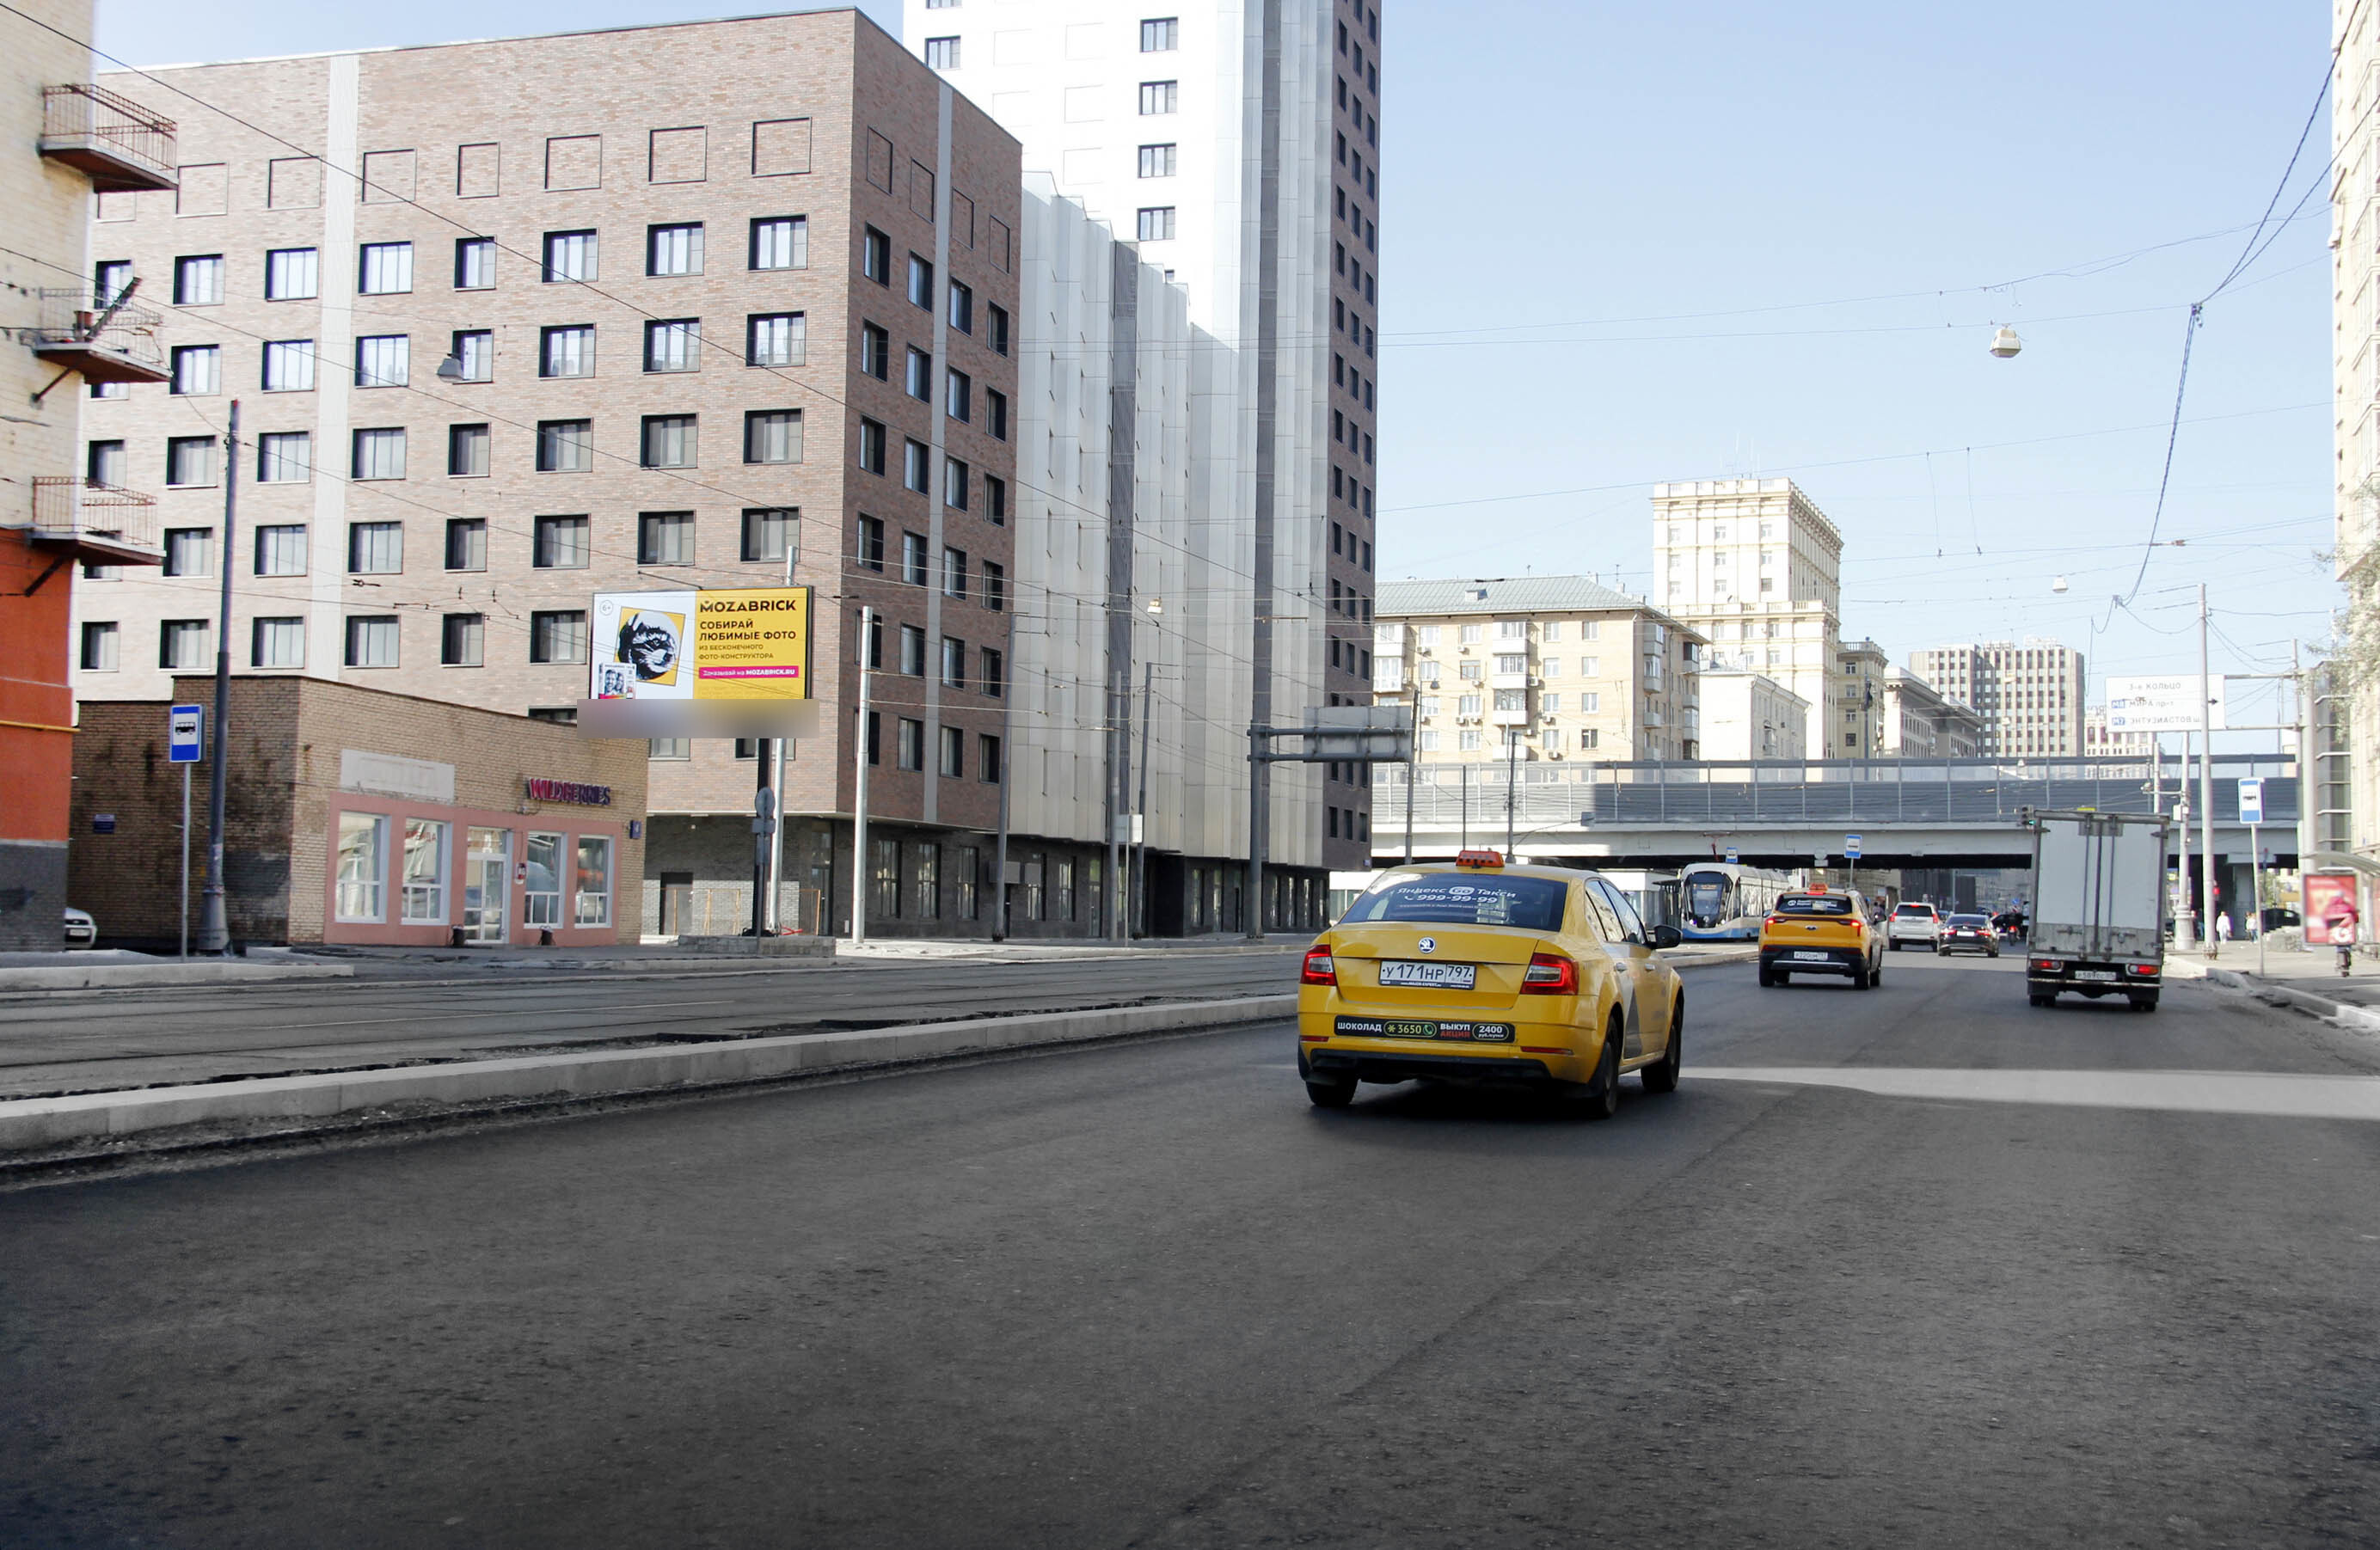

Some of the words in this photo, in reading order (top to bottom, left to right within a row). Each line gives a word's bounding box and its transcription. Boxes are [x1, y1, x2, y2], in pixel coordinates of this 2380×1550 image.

[700, 600, 796, 613] MOZABRICK
[700, 618, 753, 629] СОБИРАЙ
[699, 632, 761, 641] ЛЮБИМЫЕ
[764, 631, 796, 640] ФОТО
[529, 777, 611, 806] WILDBERRIES
[1477, 888, 1518, 898] Такси
[1416, 894, 1498, 904] 999-99-99
[1447, 965, 1470, 977] 797
[1337, 1021, 1383, 1032] ШОКОЛАД
